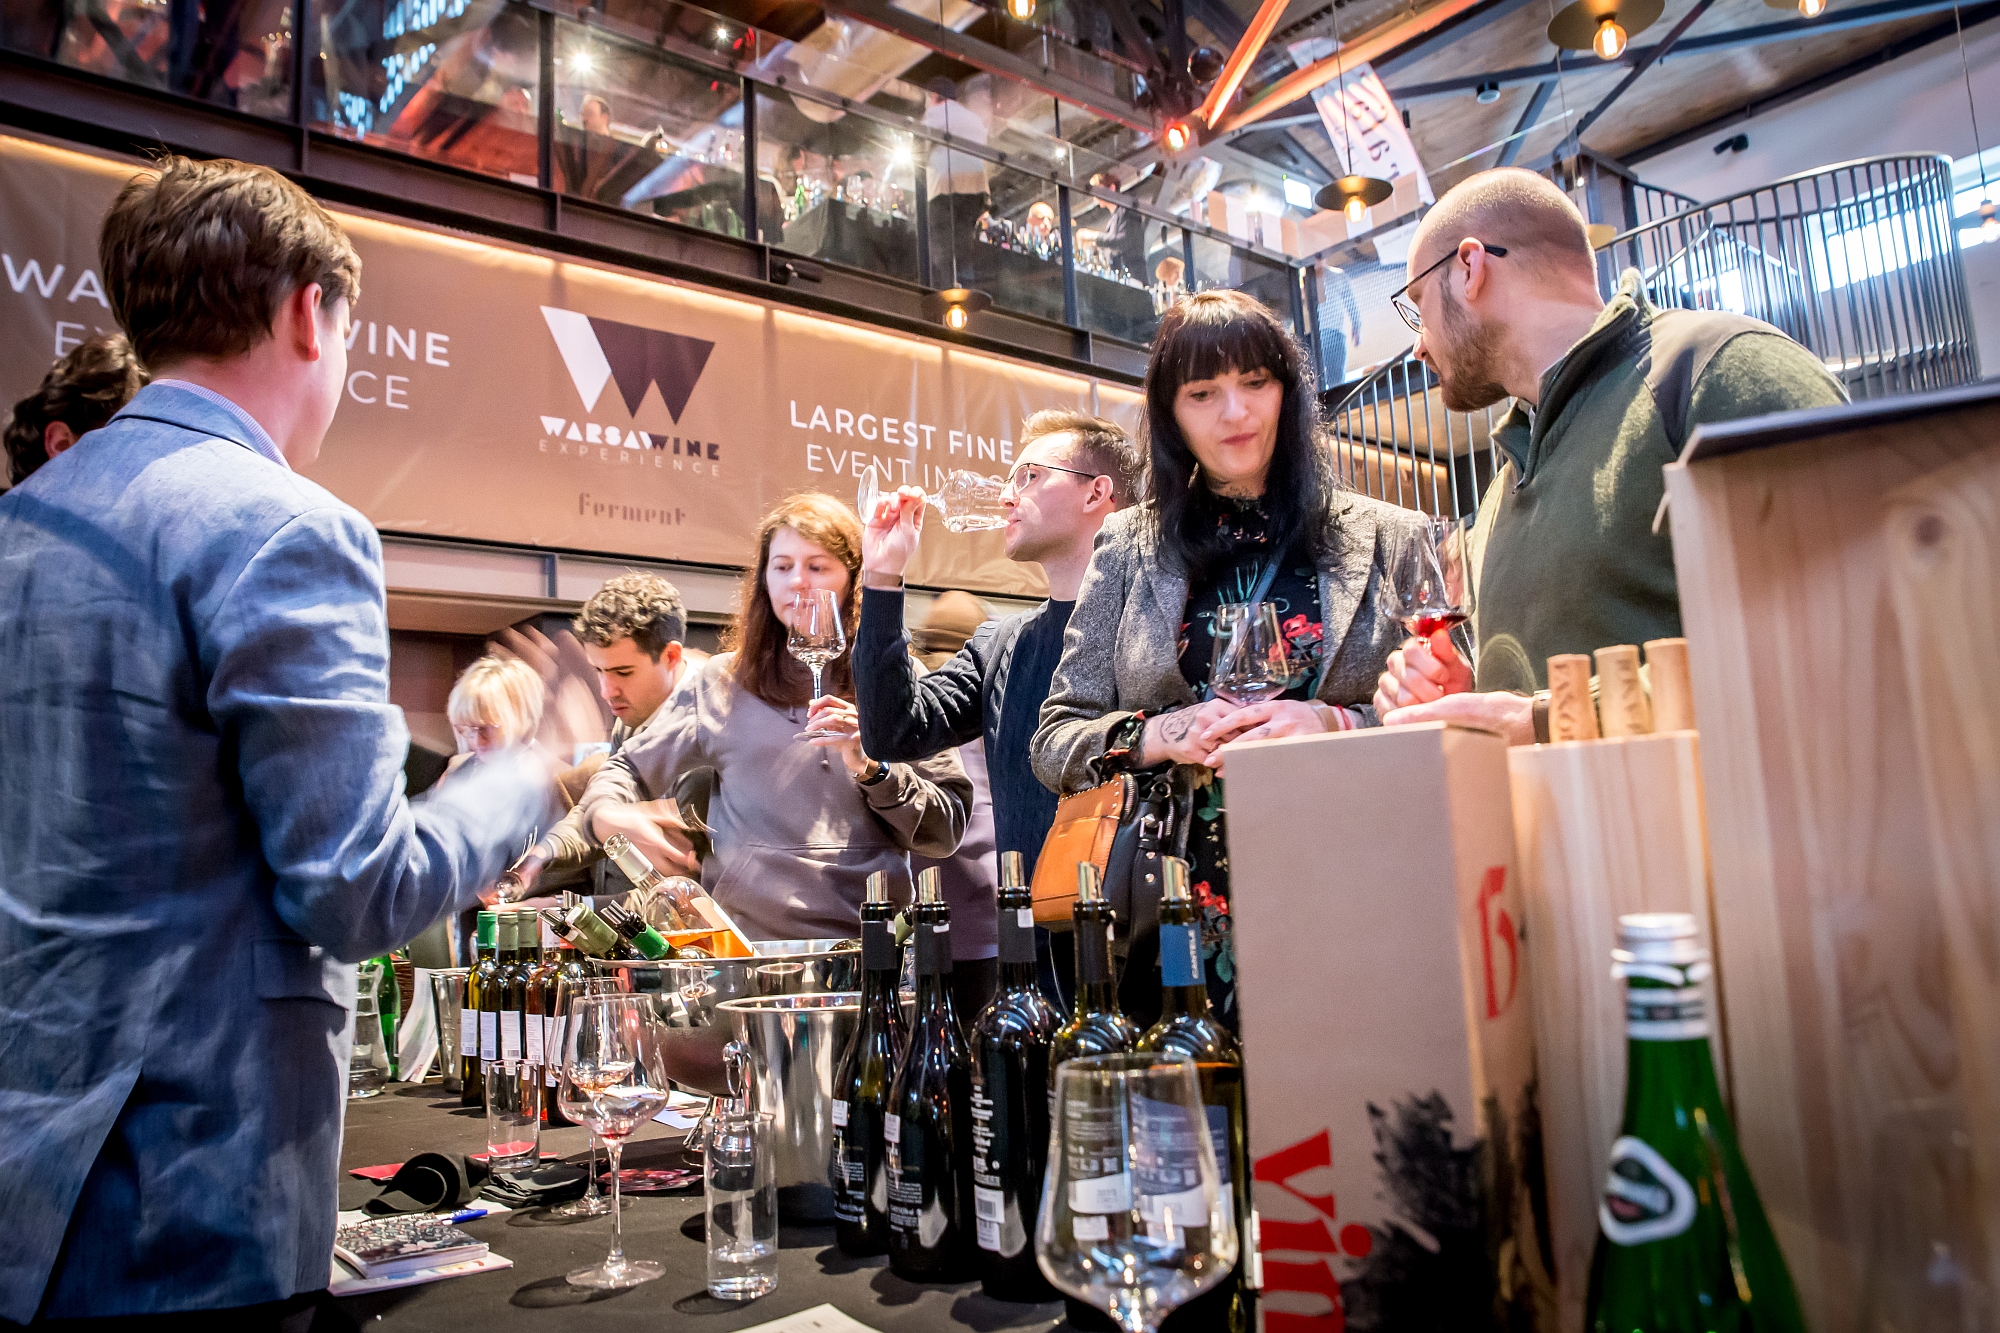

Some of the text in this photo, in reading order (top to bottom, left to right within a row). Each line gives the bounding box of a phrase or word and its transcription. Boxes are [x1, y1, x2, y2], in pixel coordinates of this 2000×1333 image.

[790, 400, 1014, 466] LARGEST FINE
[539, 439, 720, 477] EXPERIENCE
[806, 443, 912, 485] EVENT
[924, 463, 952, 490] IN
